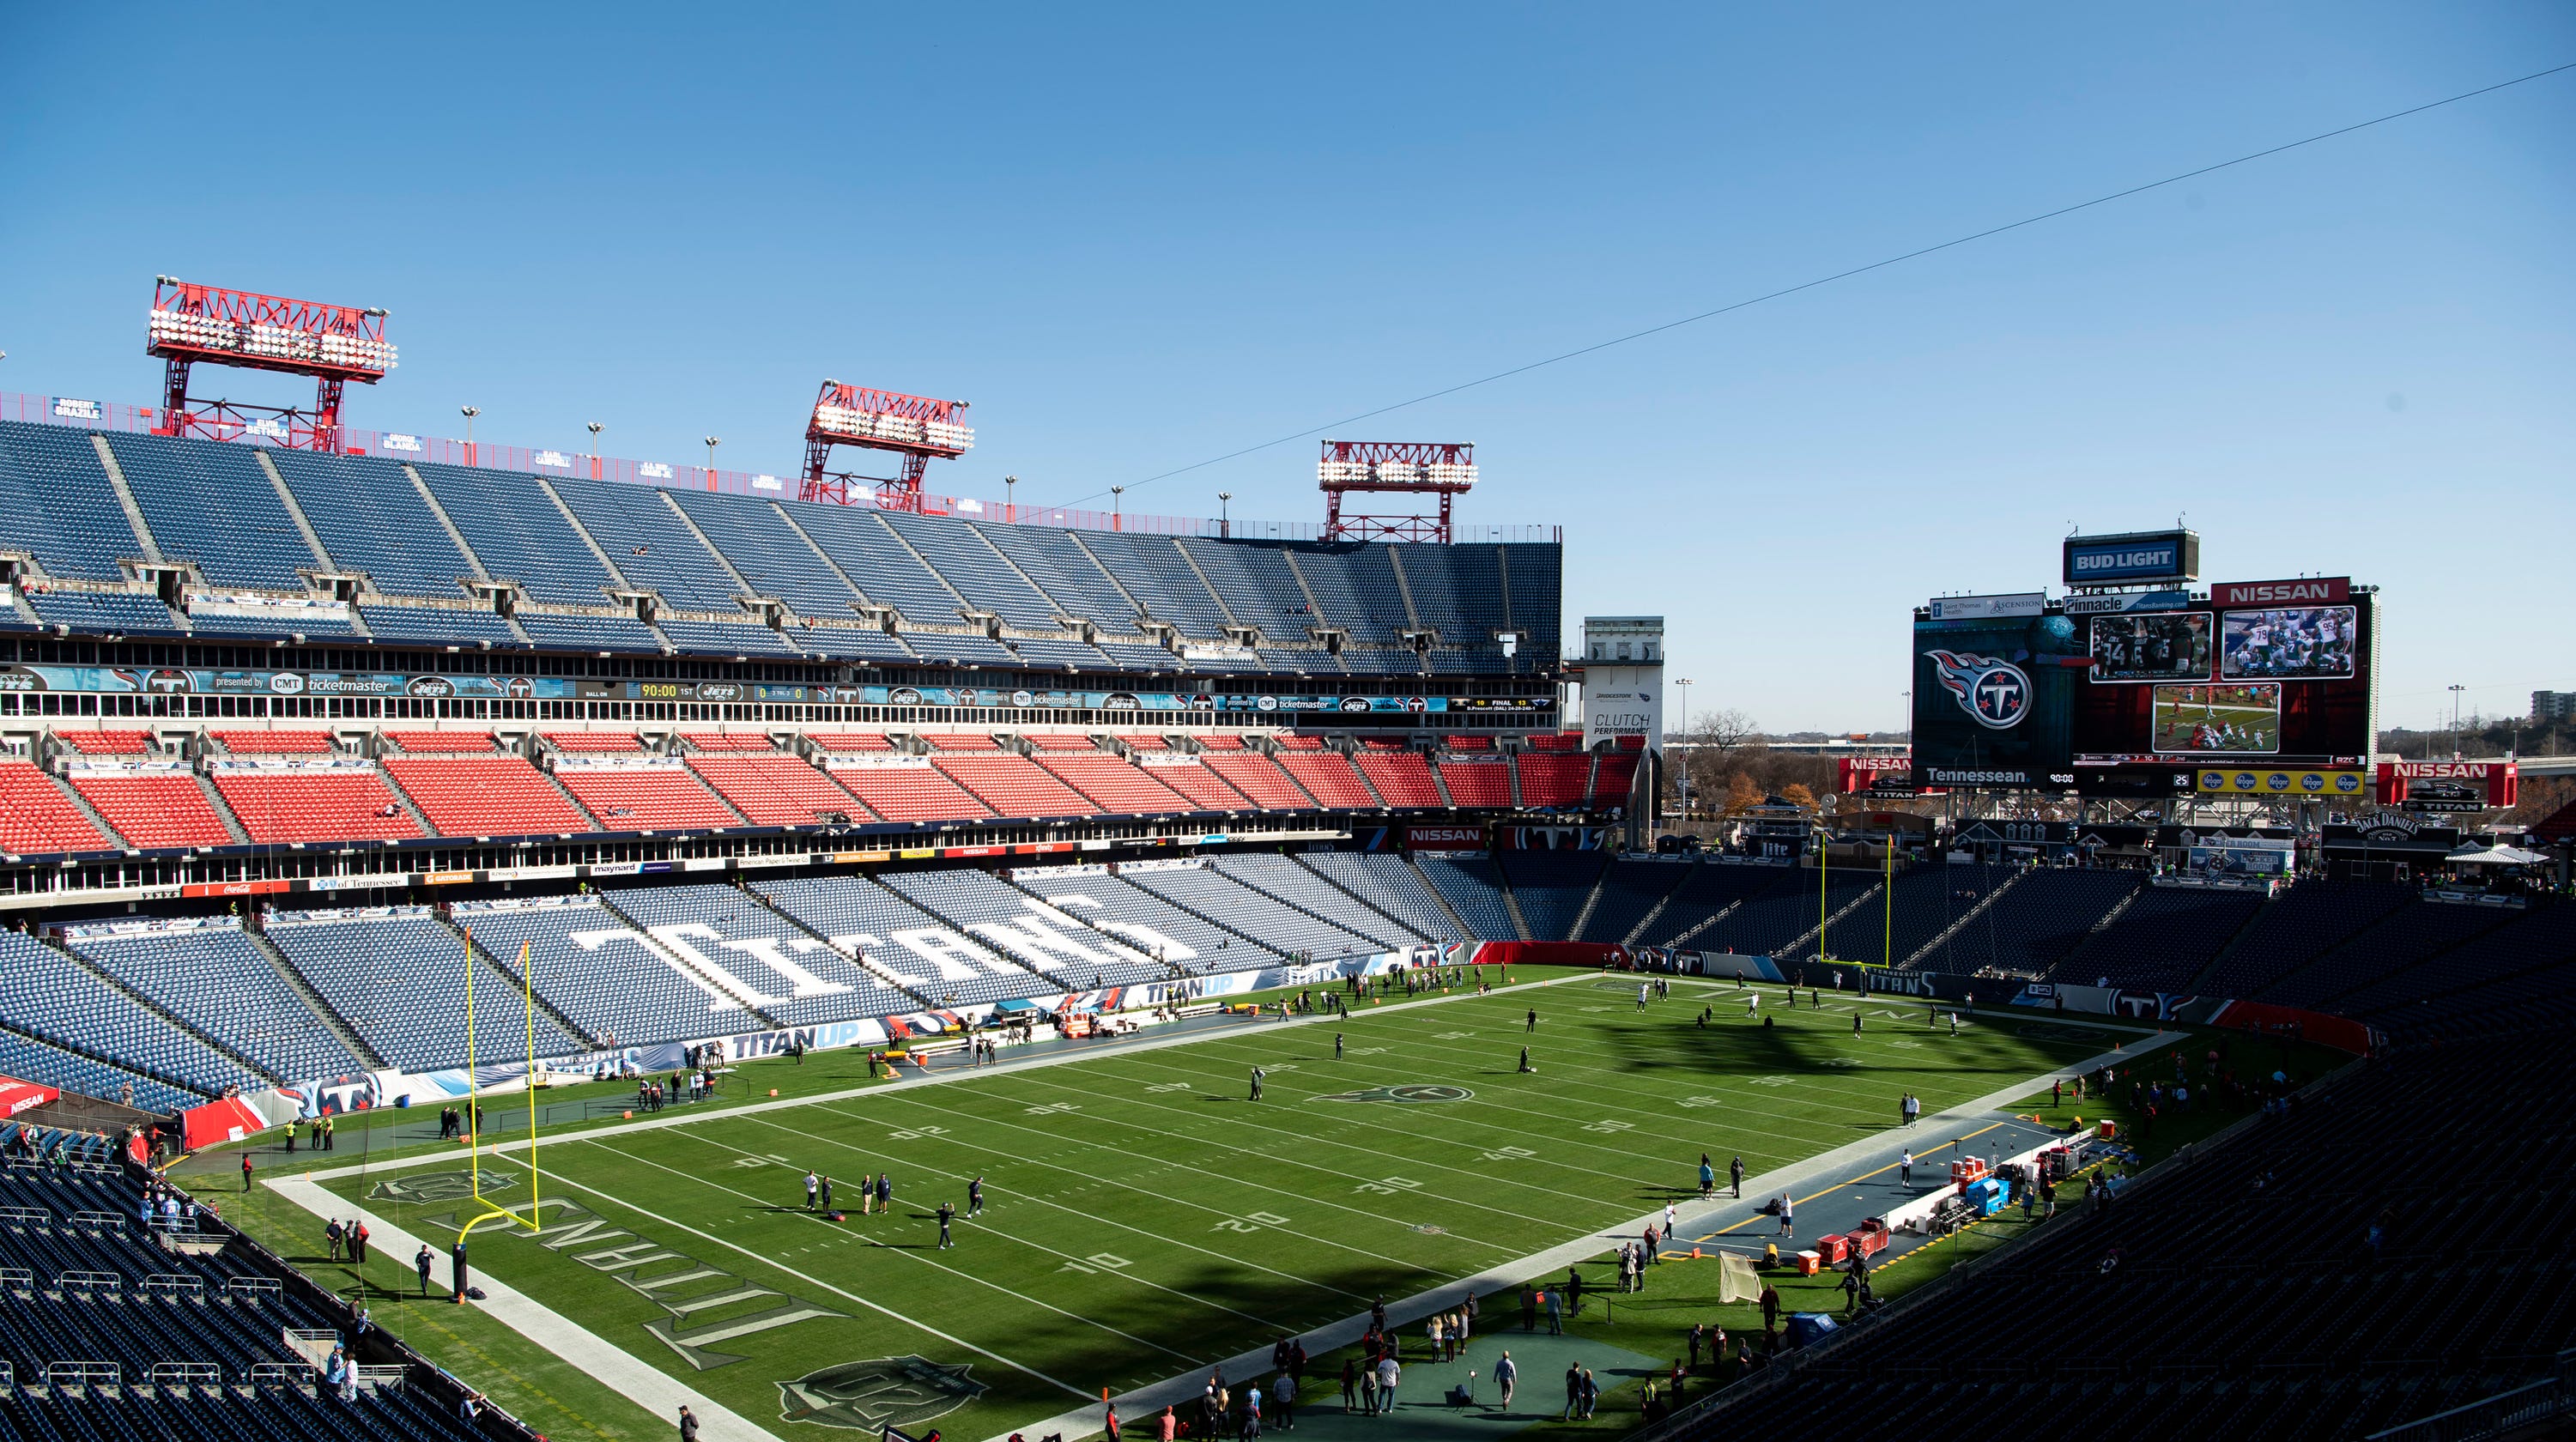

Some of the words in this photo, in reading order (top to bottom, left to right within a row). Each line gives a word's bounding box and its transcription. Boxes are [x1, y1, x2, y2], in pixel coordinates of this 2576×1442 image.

[60, 398, 94, 409] ROBERT
[55, 406, 100, 419] BRAZILE
[257, 419, 278, 428] ELVIN
[246, 426, 289, 438] BETHEA
[390, 433, 415, 444] GEORGE
[384, 439, 421, 452] BLANDA
[536, 457, 570, 468] CAMPBELL
[2076, 554, 2114, 570] BUD
[2117, 551, 2171, 567] LIGHT
[2230, 583, 2329, 603] NISSAN
[2065, 597, 2122, 612] Pinnacle
[2136, 601, 2188, 609] TitansBanking.com
[2323, 622, 2336, 633] 95
[2257, 630, 2268, 641] 79
[216, 677, 252, 688] presented
[254, 678, 264, 688] by
[275, 678, 300, 689] CMT
[308, 678, 390, 692] ticketmaster
[642, 685, 676, 697] 90:00
[703, 687, 735, 696] JETS
[759, 688, 767, 699] 0
[795, 688, 802, 699] 0
[982, 694, 1003, 702] presented
[1003, 694, 1009, 703] by
[1015, 694, 1030, 703] CMT
[1033, 694, 1080, 705] ticketmaster
[1260, 699, 1276, 707] CMT
[1279, 700, 1329, 709] ticketmaster
[1595, 714, 1651, 726] CLUTCH
[1850, 759, 1912, 770] NISSAN
[2393, 764, 2488, 778] NISSAN
[2050, 773, 2074, 783] 90:00
[2175, 775, 2187, 785] 25
[2203, 774, 2223, 789] Kroger
[2235, 774, 2255, 789] Kroger
[2269, 774, 2288, 790] Kroger
[2303, 775, 2322, 790] Kroger
[2337, 775, 2357, 791] Kroger
[2356, 815, 2379, 833] JACK
[1410, 829, 1480, 841] NISSAN
[595, 863, 636, 874] maynard
[2246, 863, 2273, 871] ROOM
[349, 879, 402, 888] Tennessee
[435, 874, 472, 882] GATORADE
[570, 894, 1198, 1010] TITANS
[1873, 967, 1920, 977] TENNESSEE
[11, 1093, 44, 1114] NISSAN
[1580, 1118, 1636, 1134] 50
[888, 1125, 952, 1140] 20
[1482, 1145, 1538, 1160] 40
[733, 1154, 790, 1168] 10
[1356, 1176, 1425, 1195] 30
[1215, 1211, 1291, 1233] 20
[1064, 1252, 1135, 1275] 10
[1809, 1259, 1817, 1269] G
[421, 1194, 857, 1371] TITANS
